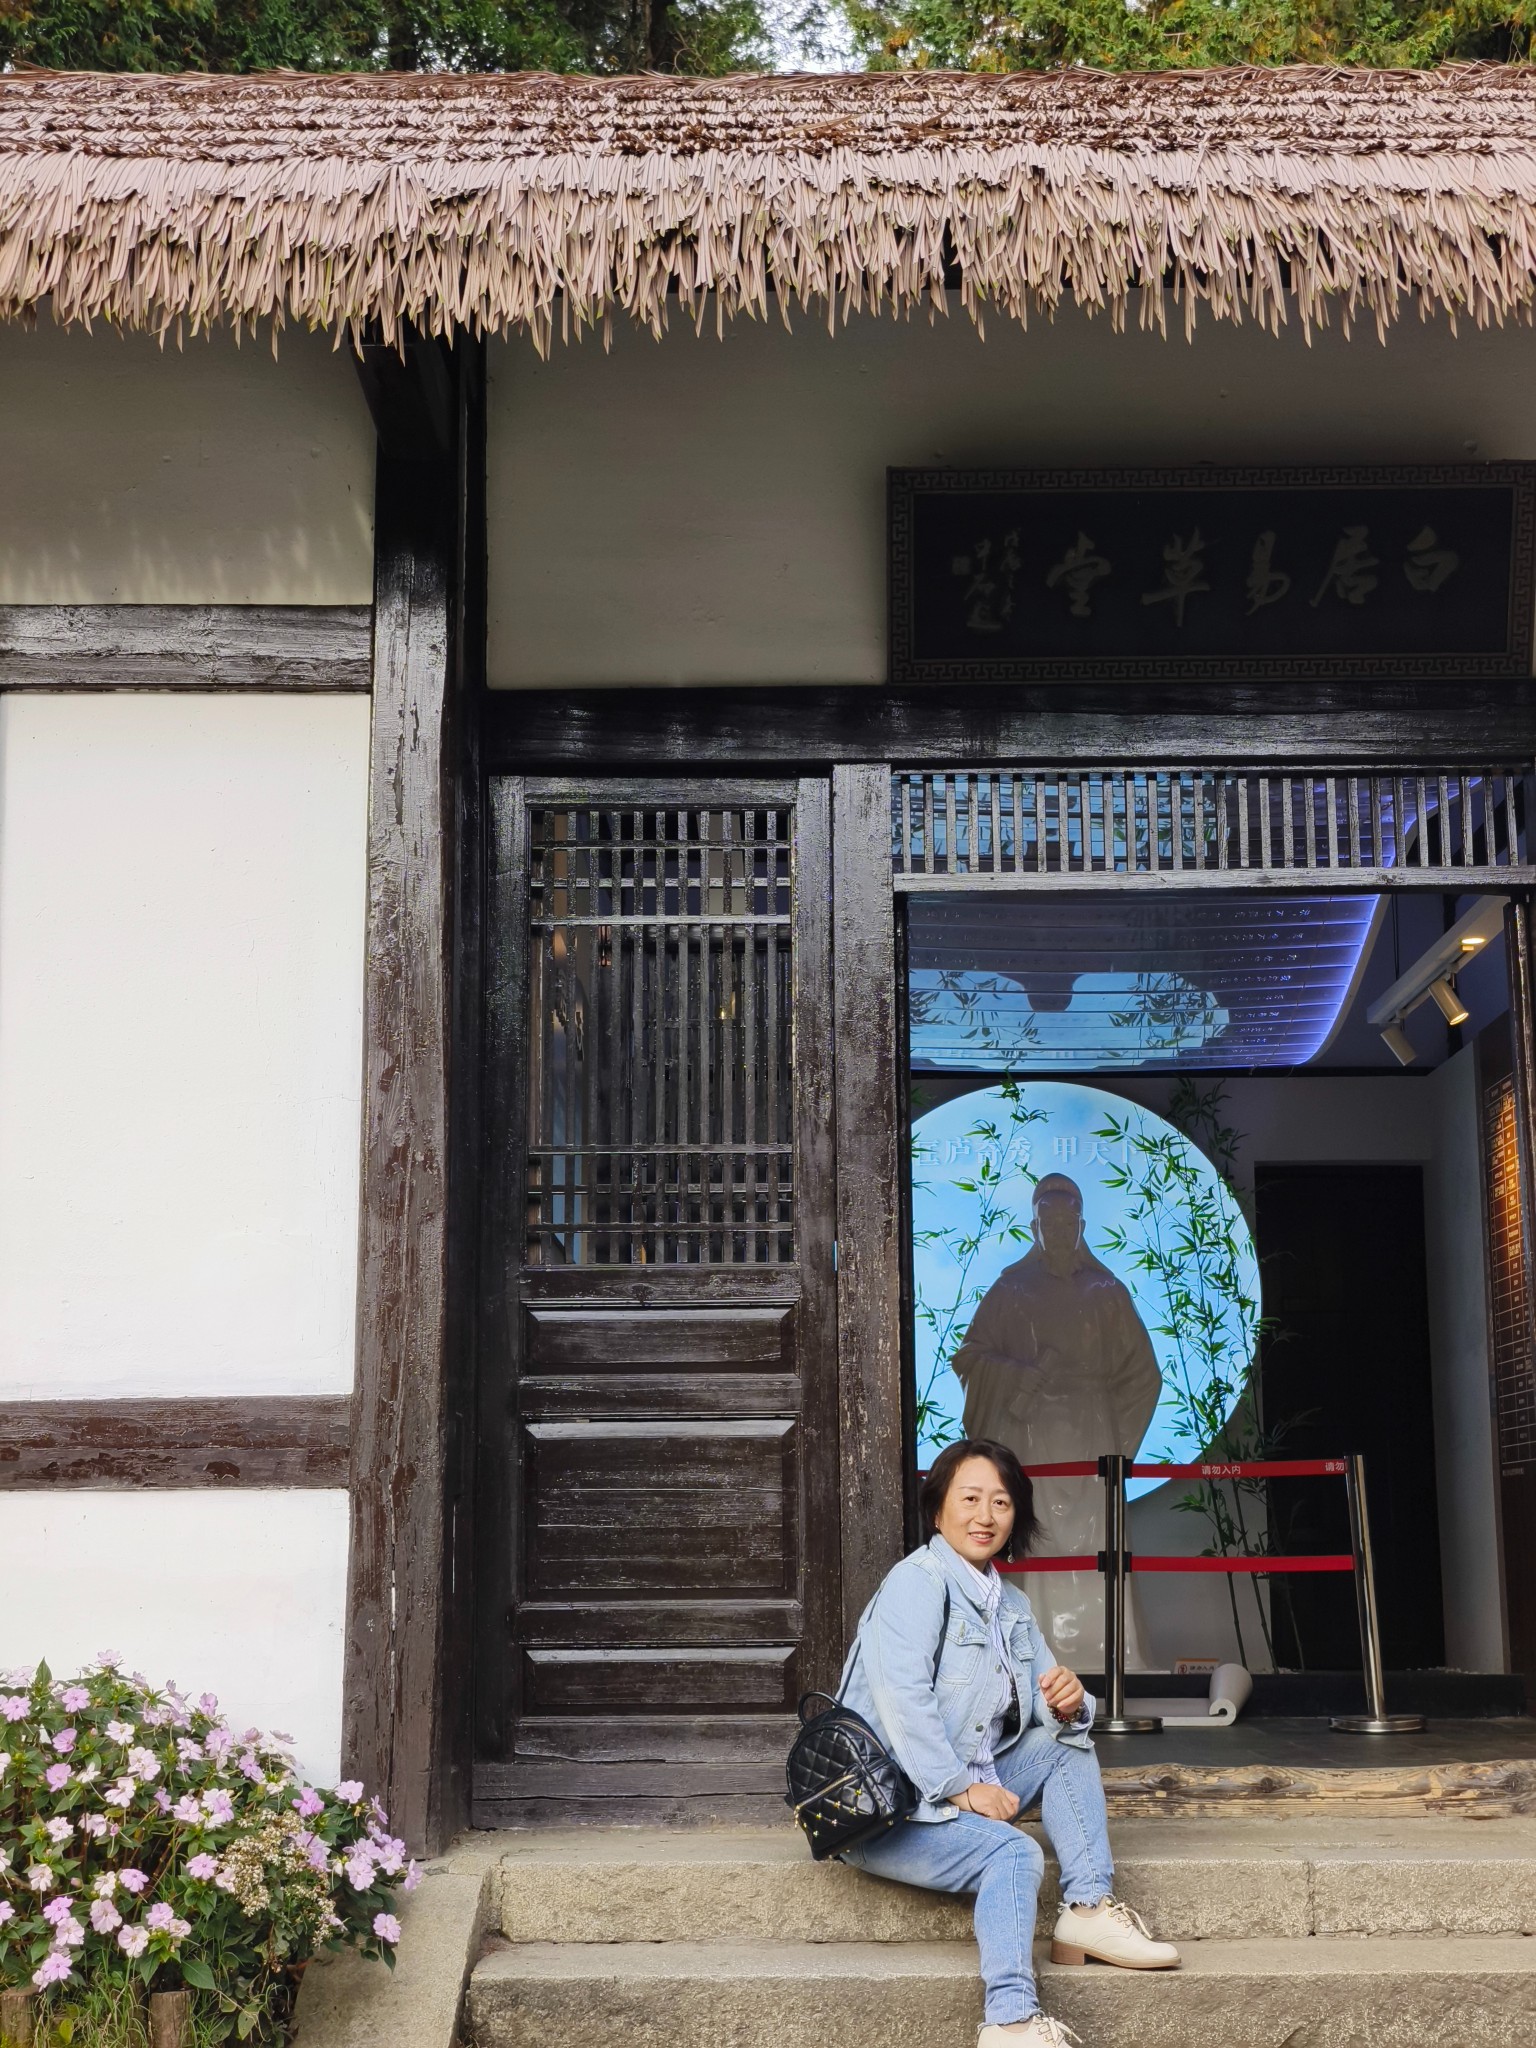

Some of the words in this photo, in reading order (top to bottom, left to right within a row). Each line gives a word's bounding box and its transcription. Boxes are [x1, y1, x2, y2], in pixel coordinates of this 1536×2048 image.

[1046, 524, 1459, 627] 白居易草堂
[1202, 1465, 1242, 1475] 请勿入内
